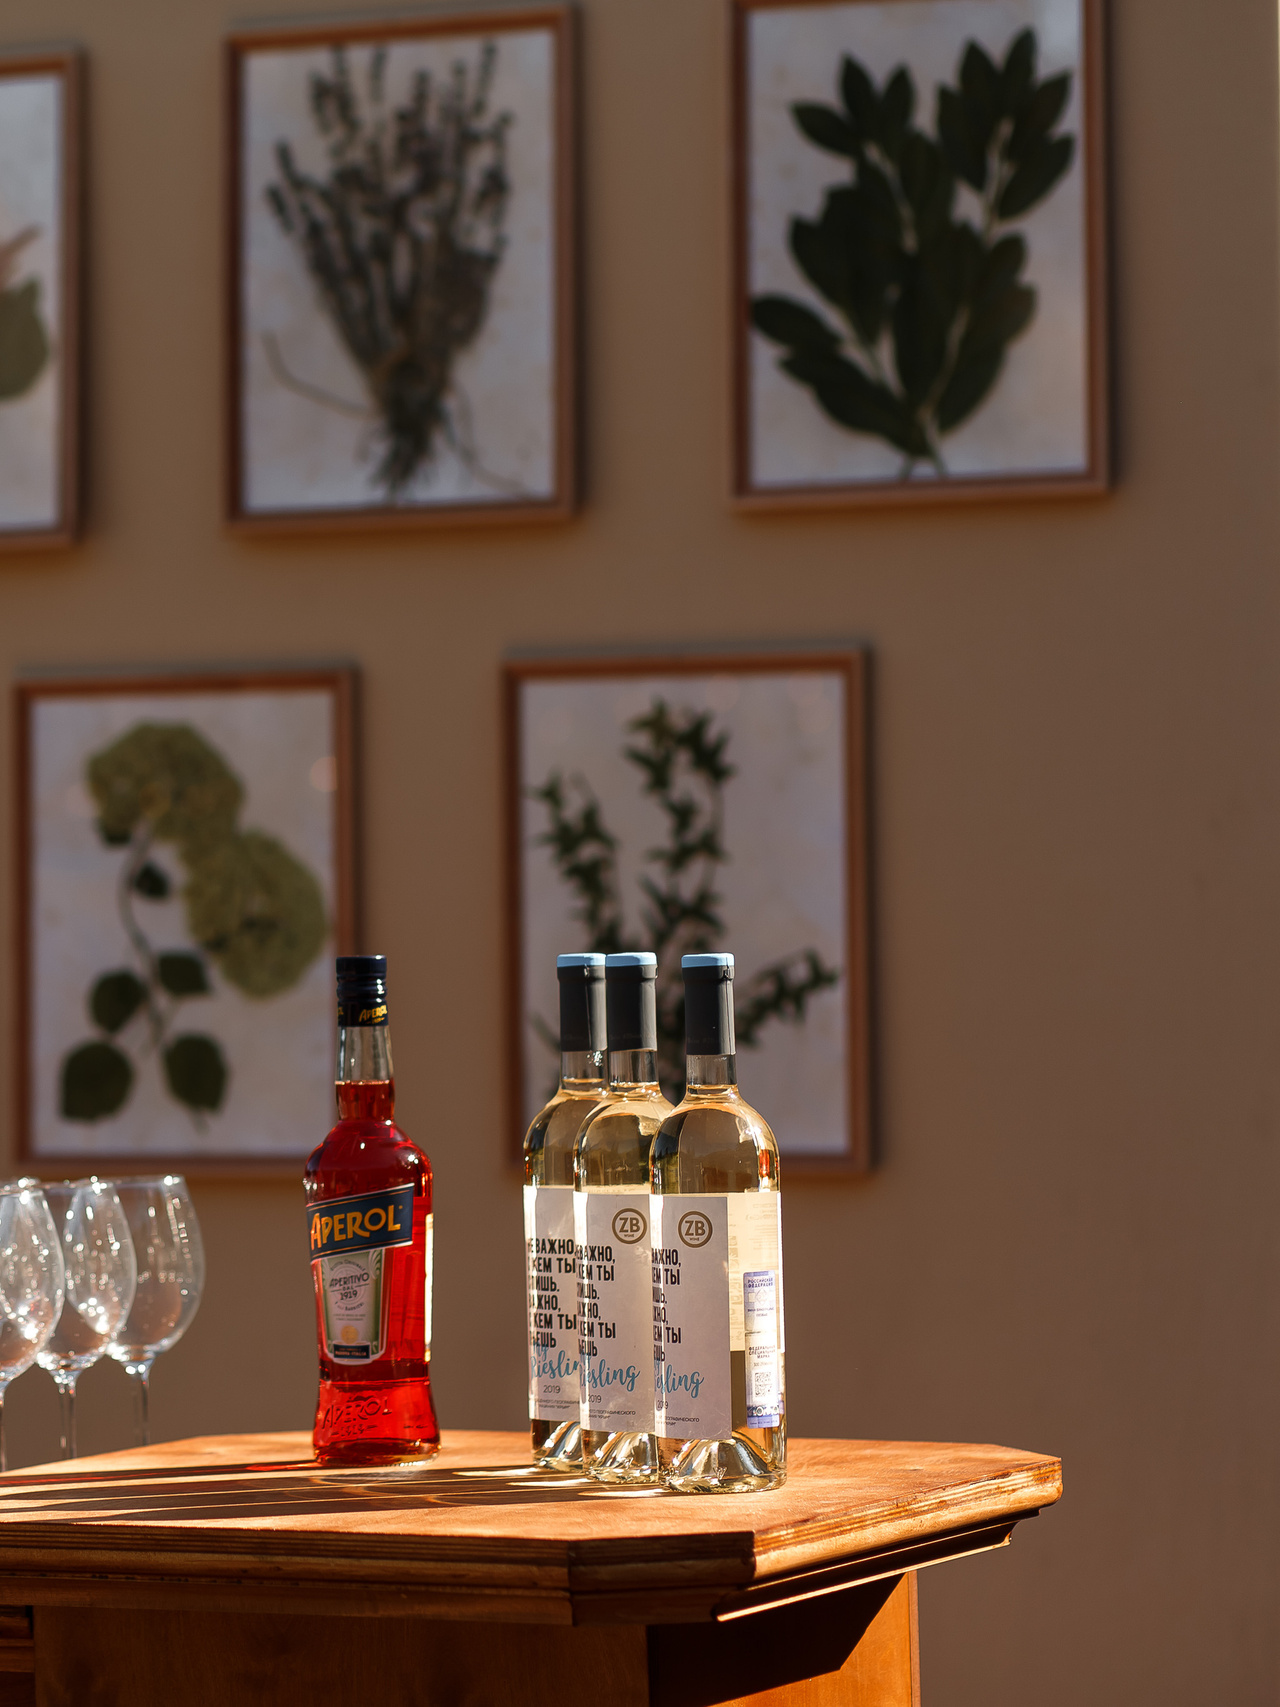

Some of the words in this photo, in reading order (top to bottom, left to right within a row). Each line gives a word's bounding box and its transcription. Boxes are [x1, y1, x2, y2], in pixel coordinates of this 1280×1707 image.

[310, 1204, 401, 1250] APEROL
[618, 1217, 640, 1233] ZB
[684, 1220, 706, 1237] ZB
[556, 1258, 576, 1273] ТЫ
[596, 1265, 615, 1281] ТЫ
[329, 1272, 370, 1287] APERITIVO
[664, 1268, 680, 1285] ТЫ
[340, 1290, 358, 1301] 1919
[557, 1314, 577, 1330] ТЫ
[598, 1322, 616, 1339] ТЫ
[665, 1327, 682, 1344] ТЫ
[543, 1385, 561, 1394] 2019
[657, 1400, 669, 1410] 209
